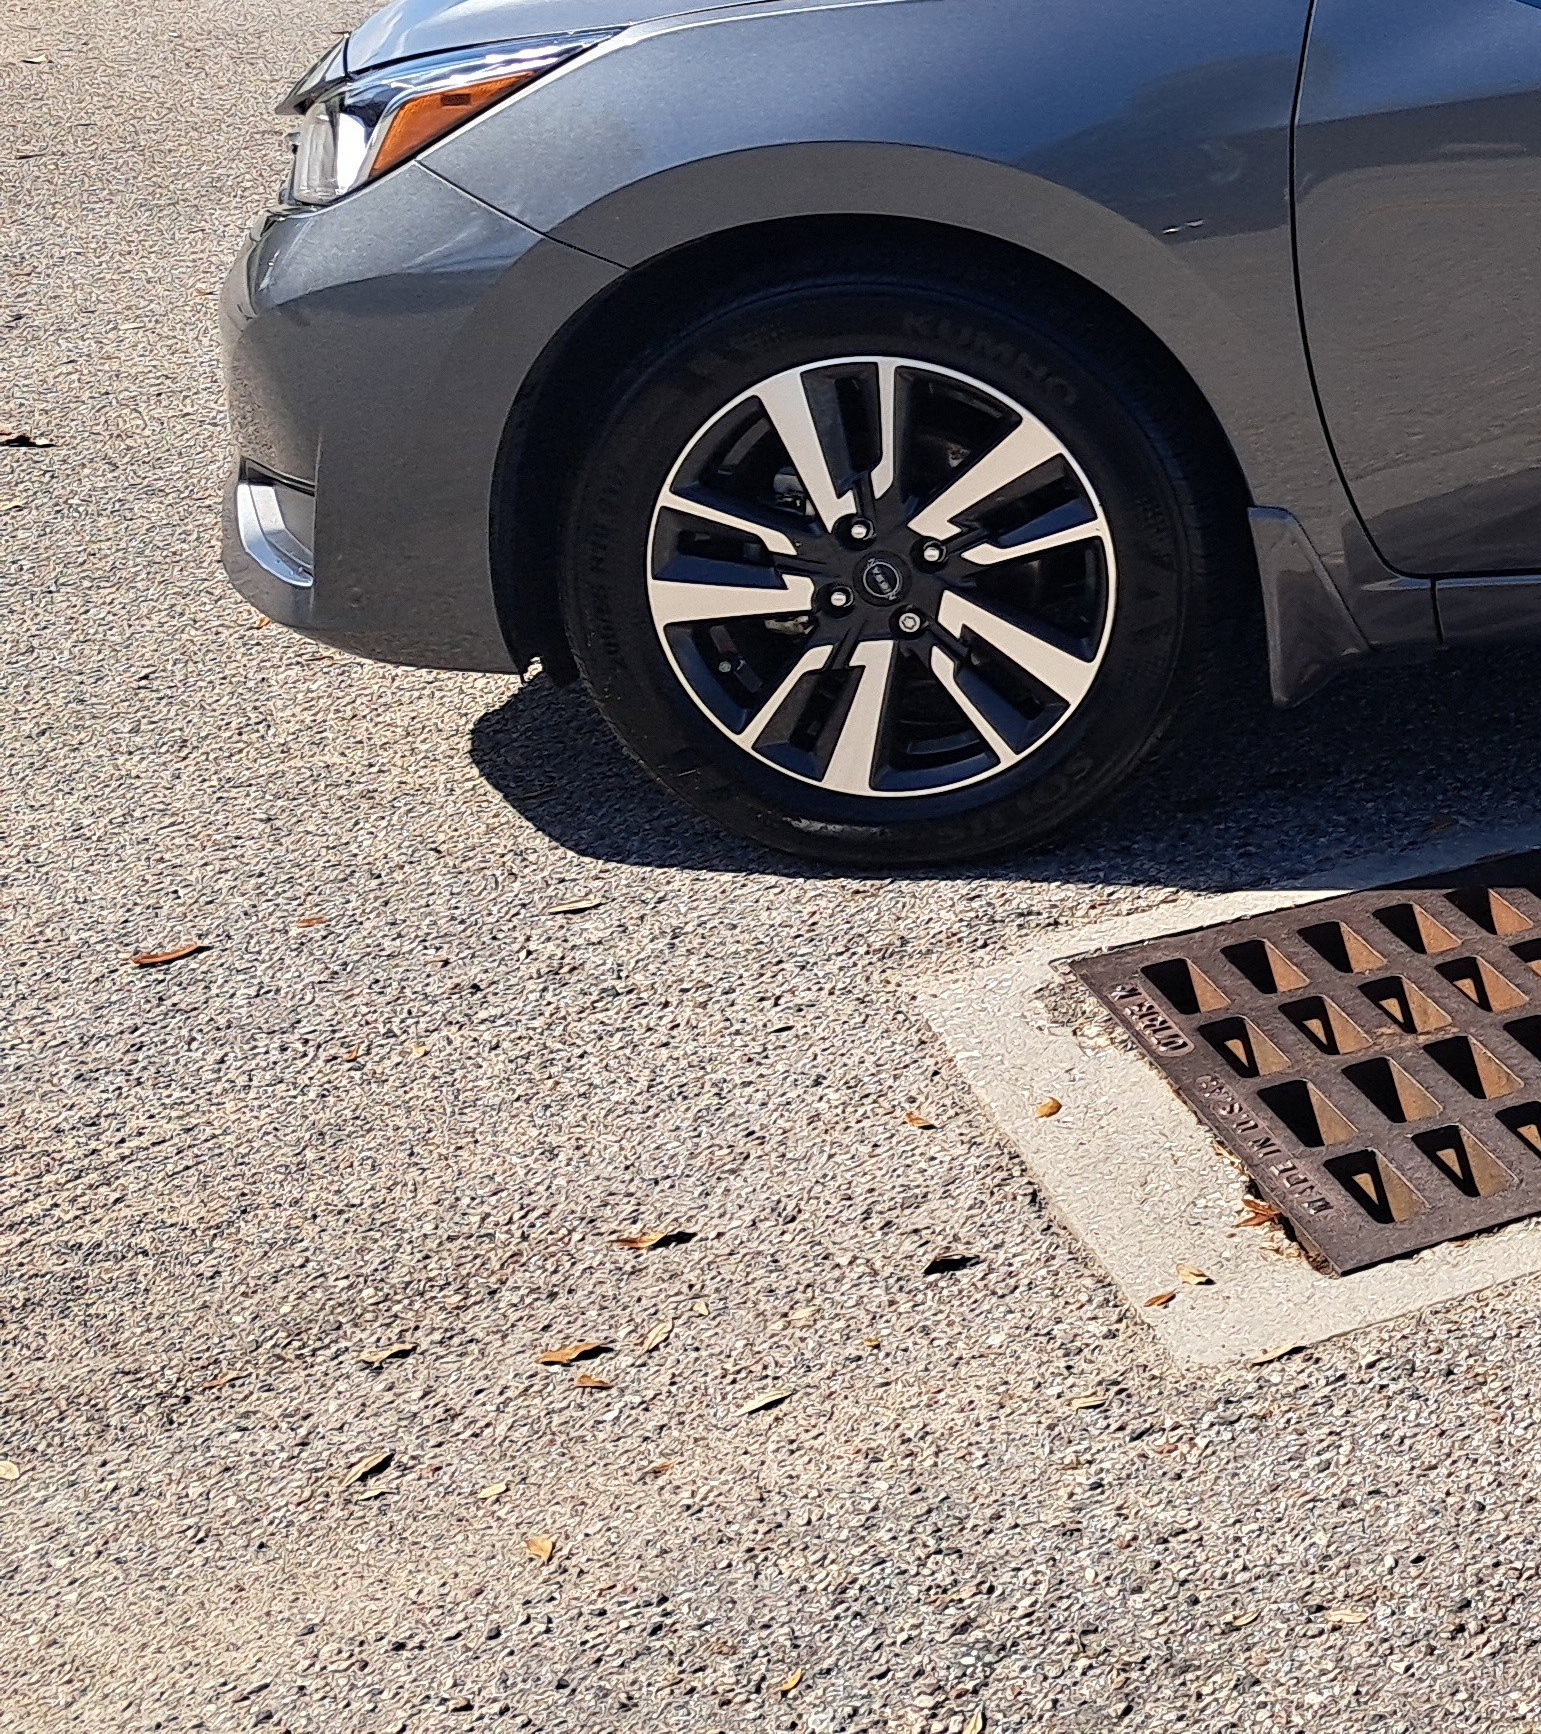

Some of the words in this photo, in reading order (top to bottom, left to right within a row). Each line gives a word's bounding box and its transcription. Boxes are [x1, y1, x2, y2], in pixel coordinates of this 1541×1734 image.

[902, 313, 1077, 406] KUMHO
[1248, 1136, 1281, 1158] IN
[1269, 1160, 1334, 1215] MADE
